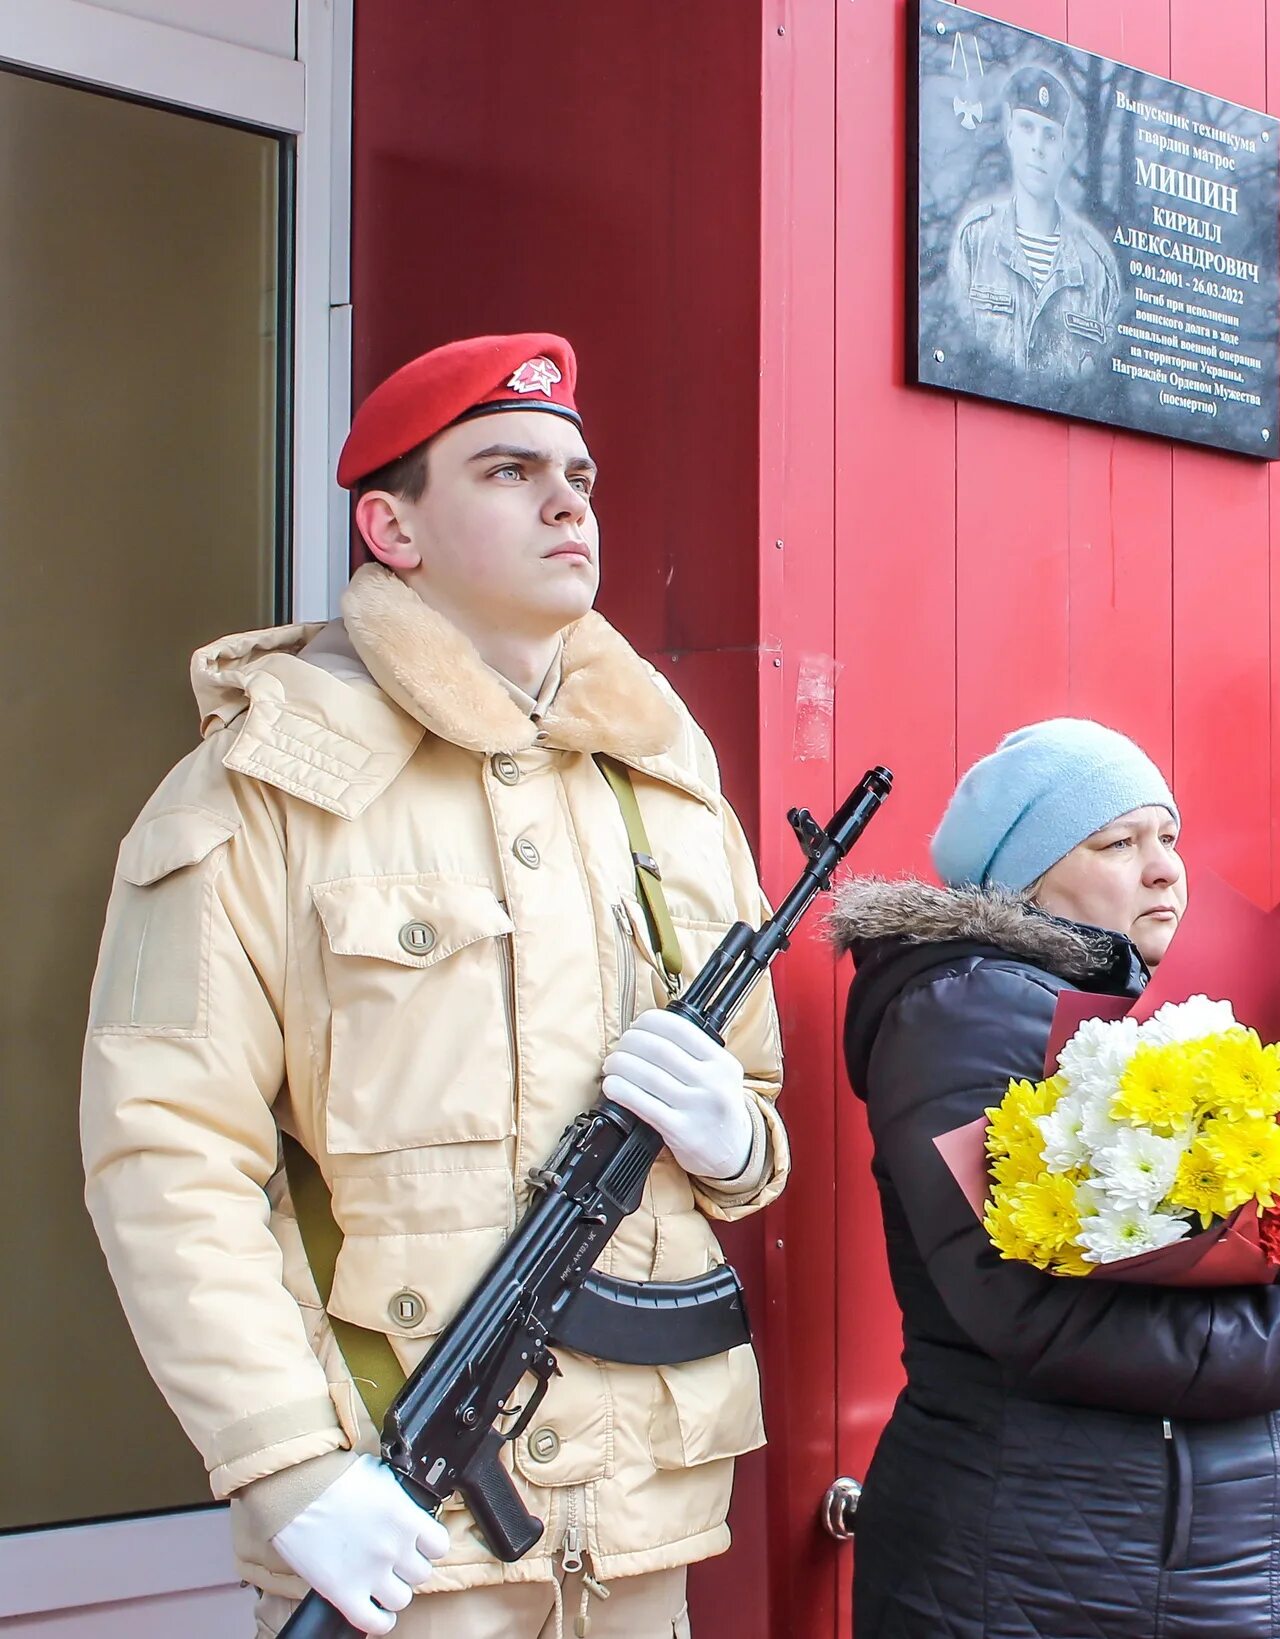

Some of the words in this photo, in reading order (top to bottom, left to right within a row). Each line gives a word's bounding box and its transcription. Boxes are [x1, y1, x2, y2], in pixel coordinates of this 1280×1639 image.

[1115, 90, 1190, 131] Выпускник
[1192, 120, 1256, 153] техникума
[1138, 128, 1190, 156] гвардии
[1192, 146, 1236, 171] матрос
[1134, 157, 1238, 216] МИШИН
[1151, 206, 1222, 244] КИРИЛЛ
[1112, 225, 1259, 284] АЛЕКСАНДРОВИЧ
[1129, 260, 1183, 288] 09.01.2001
[1192, 278, 1244, 305] 26.03.2022
[1135, 286, 1165, 307] Погиб
[1166, 299, 1184, 314] при
[1186, 303, 1240, 327] исполнении
[1135, 309, 1184, 331] воинского
[1184, 322, 1210, 338] долга
[1212, 329, 1218, 339] в
[1219, 331, 1240, 346] ходе
[1117, 323, 1179, 349] специальной
[1180, 340, 1218, 358] военной
[1218, 350, 1262, 370] операции
[1130, 345, 1142, 358] на
[1143, 348, 1199, 372] территории
[1111, 357, 1168, 385] Награждён
[1169, 372, 1212, 393] Орденом
[1213, 383, 1261, 406] Мужества
[1159, 390, 1218, 418] (посмертно)
